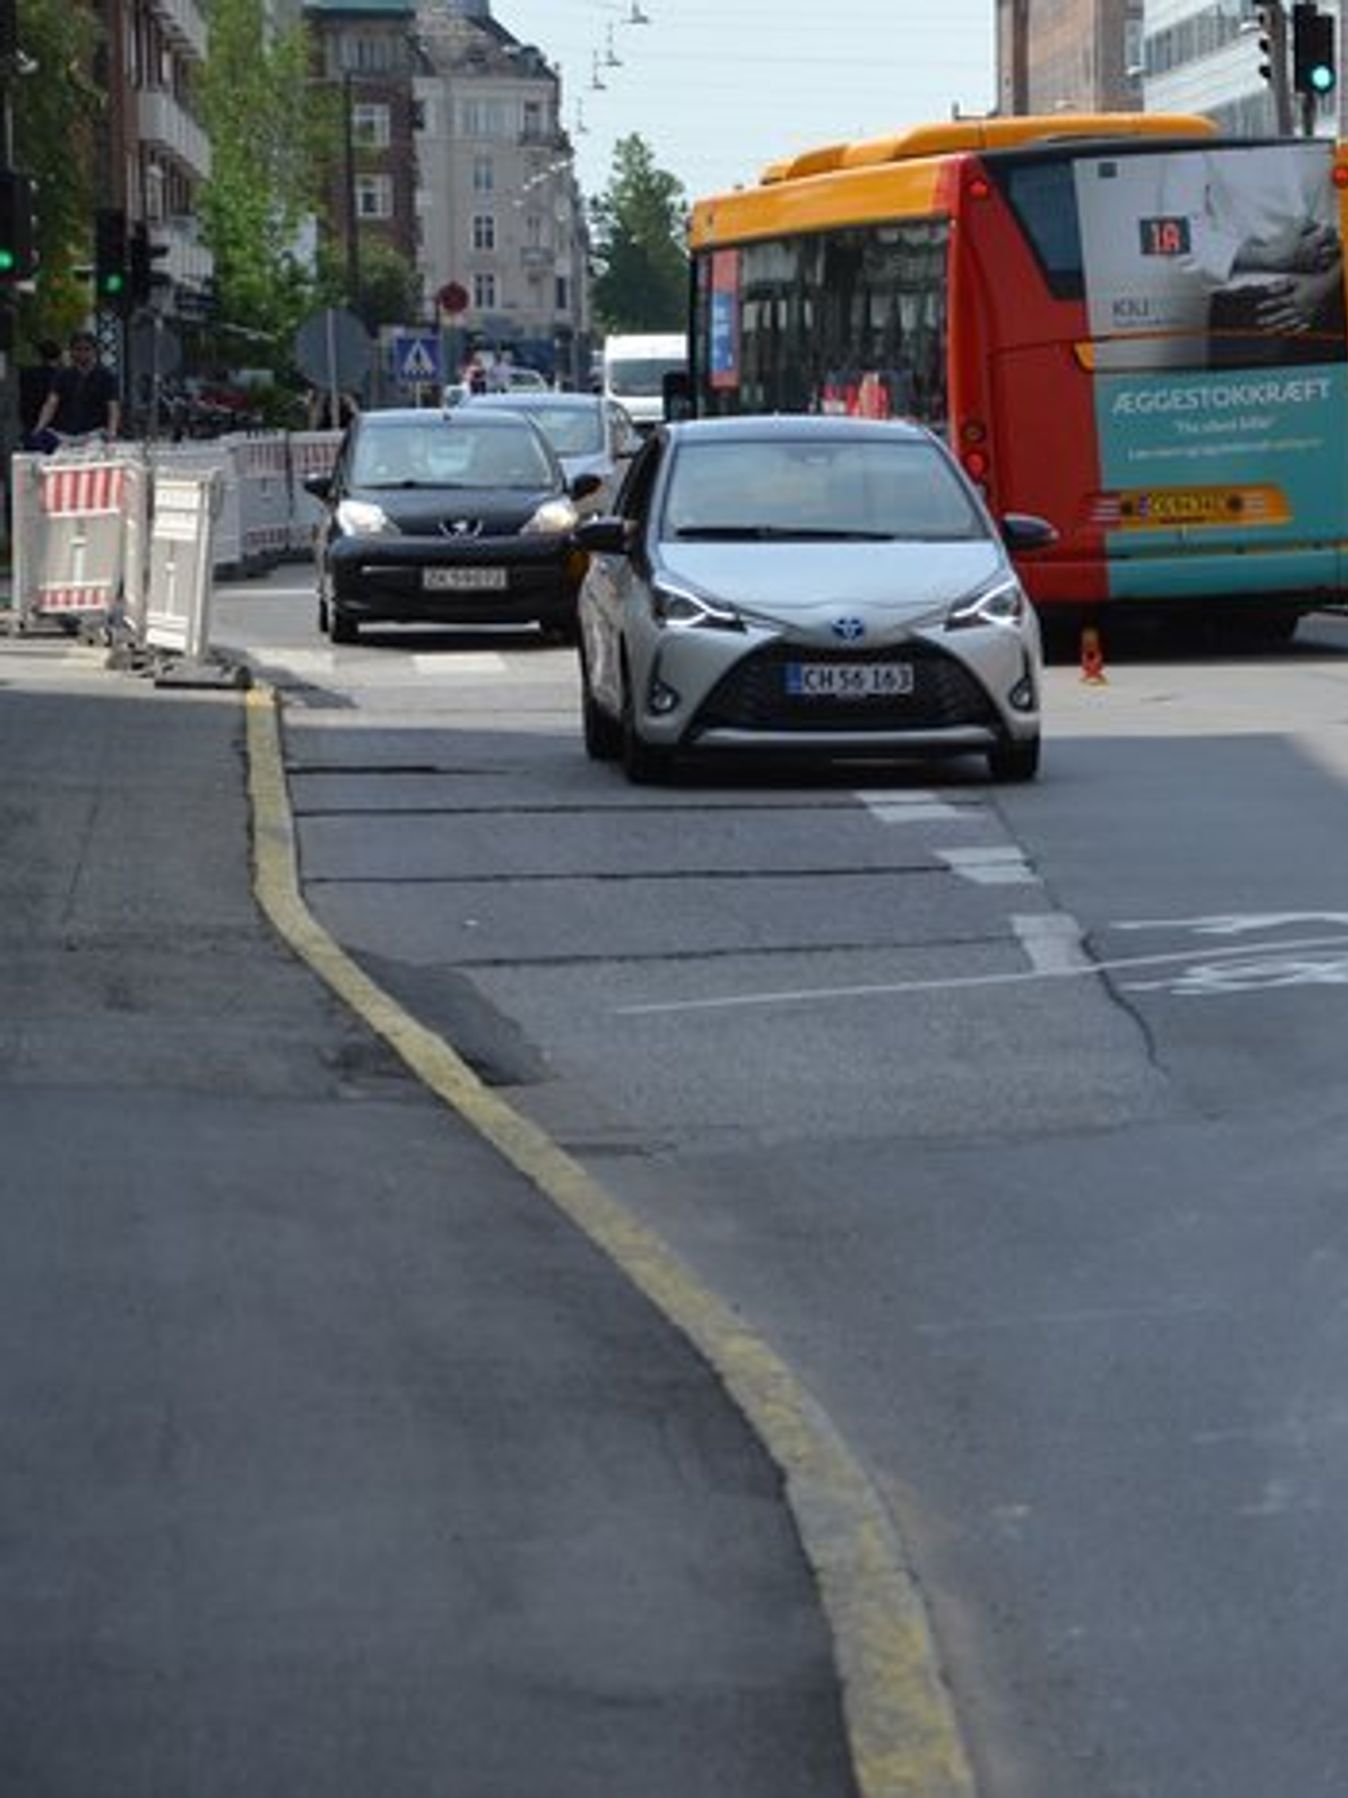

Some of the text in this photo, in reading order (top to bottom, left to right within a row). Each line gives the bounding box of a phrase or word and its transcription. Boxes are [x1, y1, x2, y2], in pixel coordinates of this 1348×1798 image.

[1151, 222, 1181, 252] 1A
[1112, 377, 1331, 414] ÆGGESTOKKRÆFT
[804, 669, 912, 690] CH 56 163
